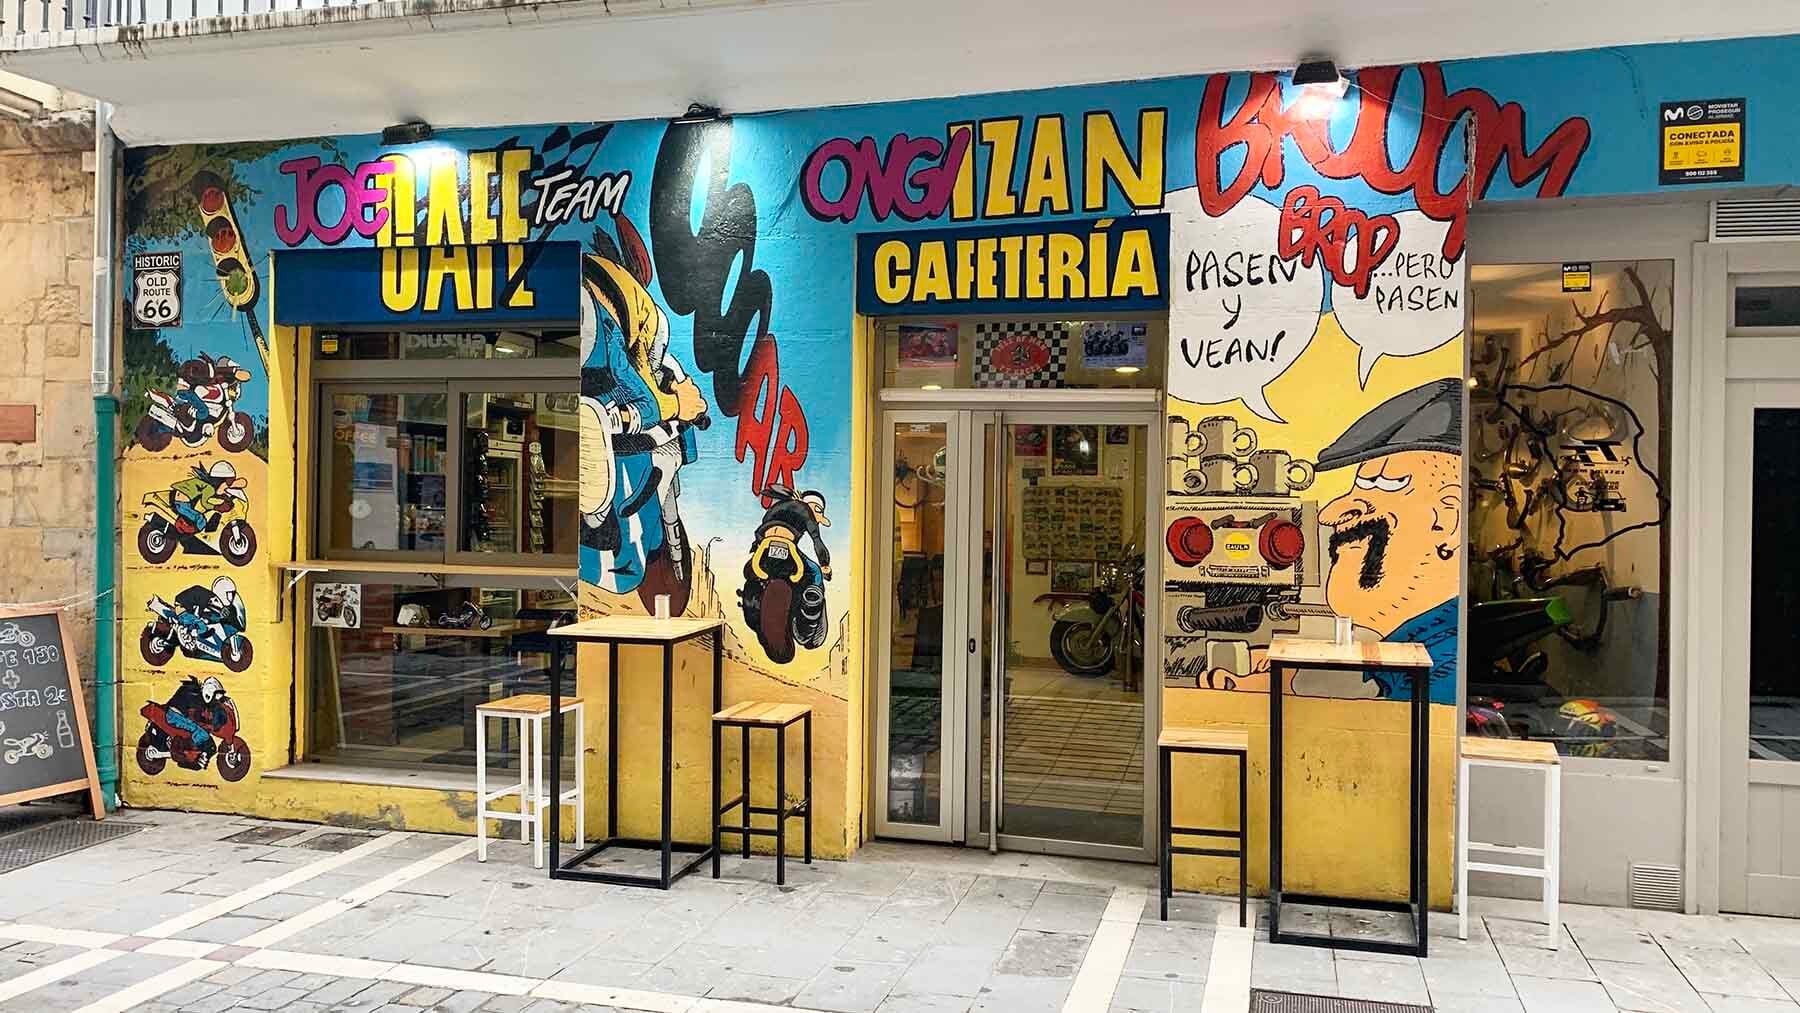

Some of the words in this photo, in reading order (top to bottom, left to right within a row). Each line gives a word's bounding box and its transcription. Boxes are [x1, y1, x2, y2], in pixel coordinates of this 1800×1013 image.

[1669, 130, 1735, 140] CONECTADA
[946, 107, 1168, 220] IZAN
[274, 157, 396, 246] JOE
[534, 169, 632, 226] TEAM
[135, 255, 180, 268] HISTORIC
[873, 218, 1160, 305] CAFETERÍA
[1186, 250, 1297, 292] PASEN
[143, 288, 171, 297] ROUTE
[146, 277, 168, 287] OLD
[143, 299, 171, 319] 66
[1375, 286, 1459, 313] PASEN
[1180, 330, 1286, 368] VEAN!
